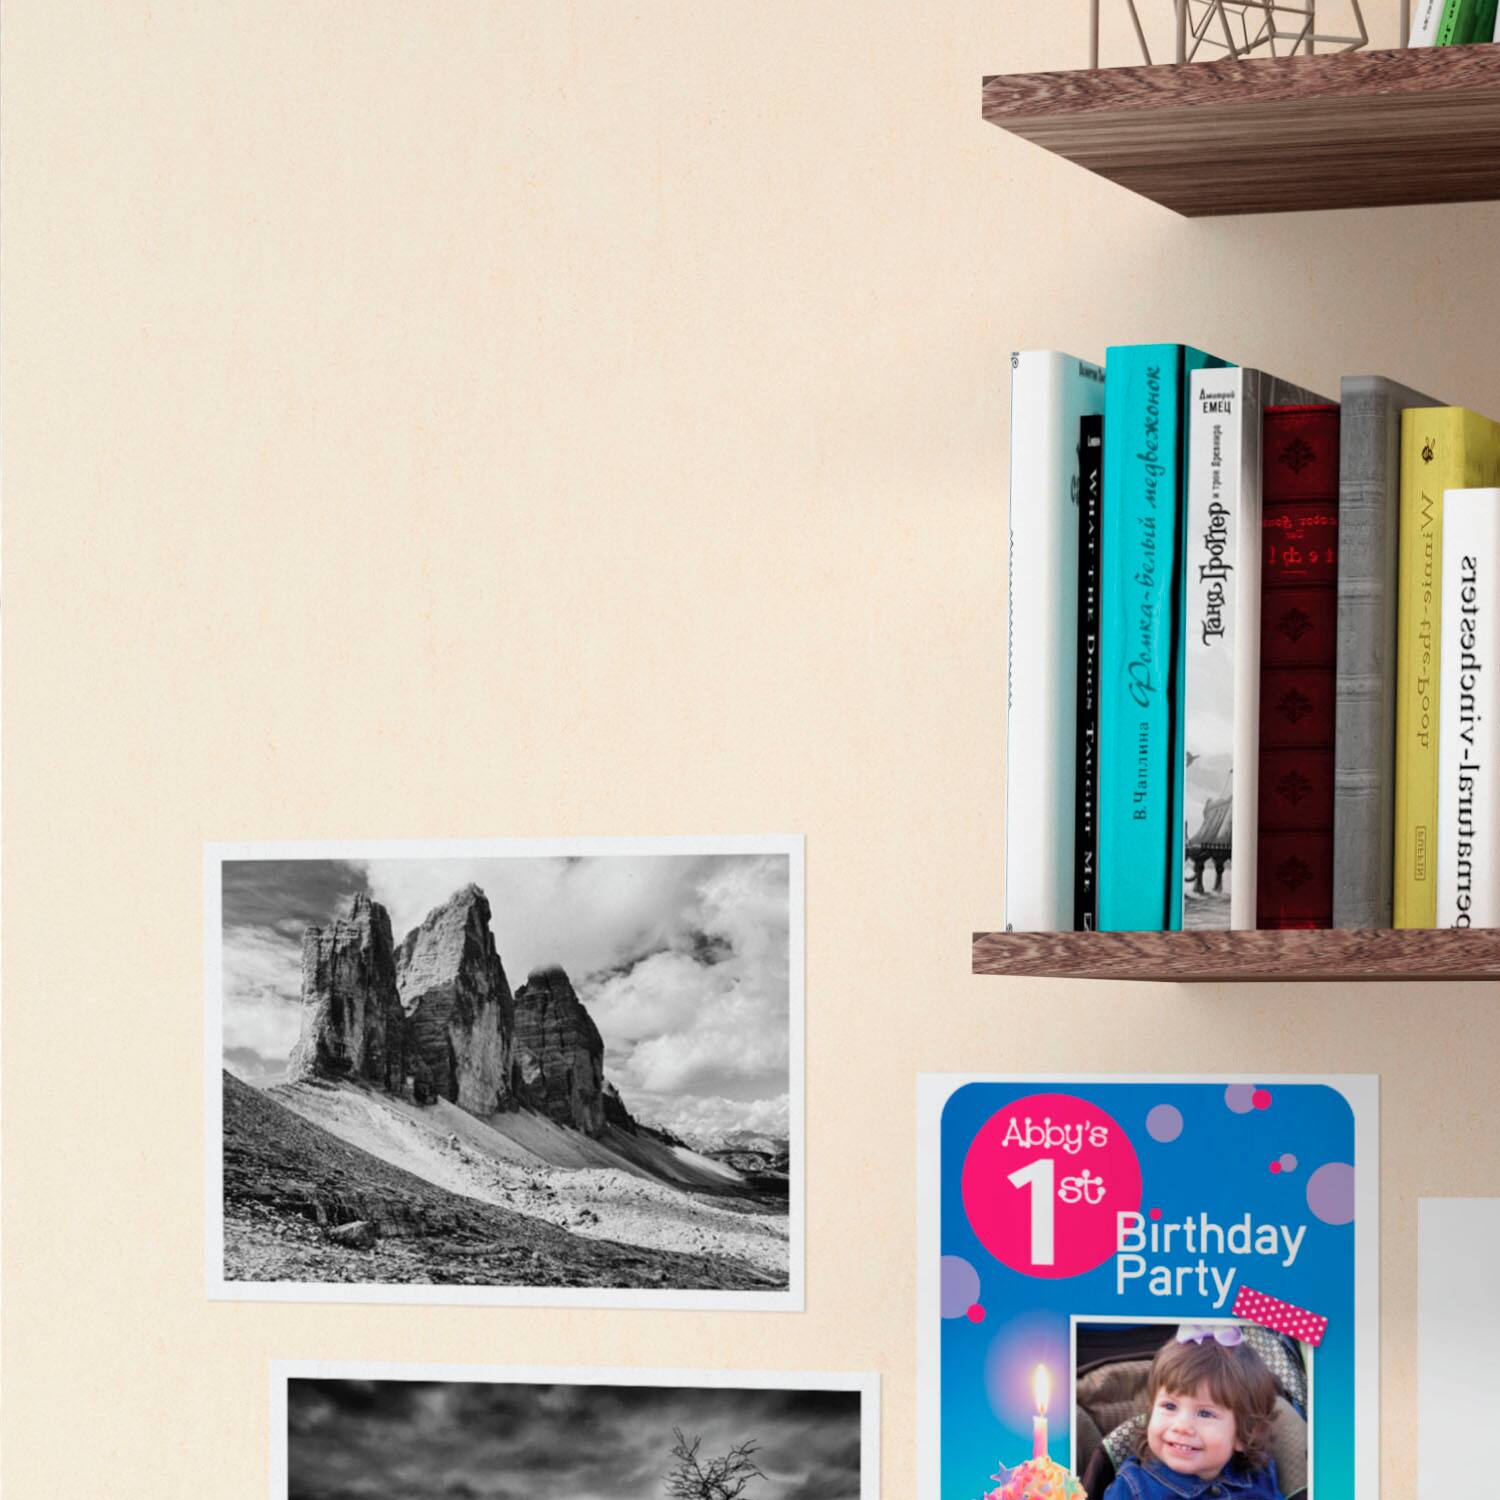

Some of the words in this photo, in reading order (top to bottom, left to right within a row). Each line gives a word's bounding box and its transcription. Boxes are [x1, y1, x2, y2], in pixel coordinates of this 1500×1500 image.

[1136, 365, 1166, 510] медвежонок
[1203, 401, 1232, 415] ЕМЕЦ
[1199, 502, 1233, 584] Гроттер
[1202, 582, 1225, 646] Таня
[1002, 1117, 1108, 1155] Abby's
[1116, 1208, 1307, 1268] Birthday
[1116, 1254, 1237, 1310] Party
